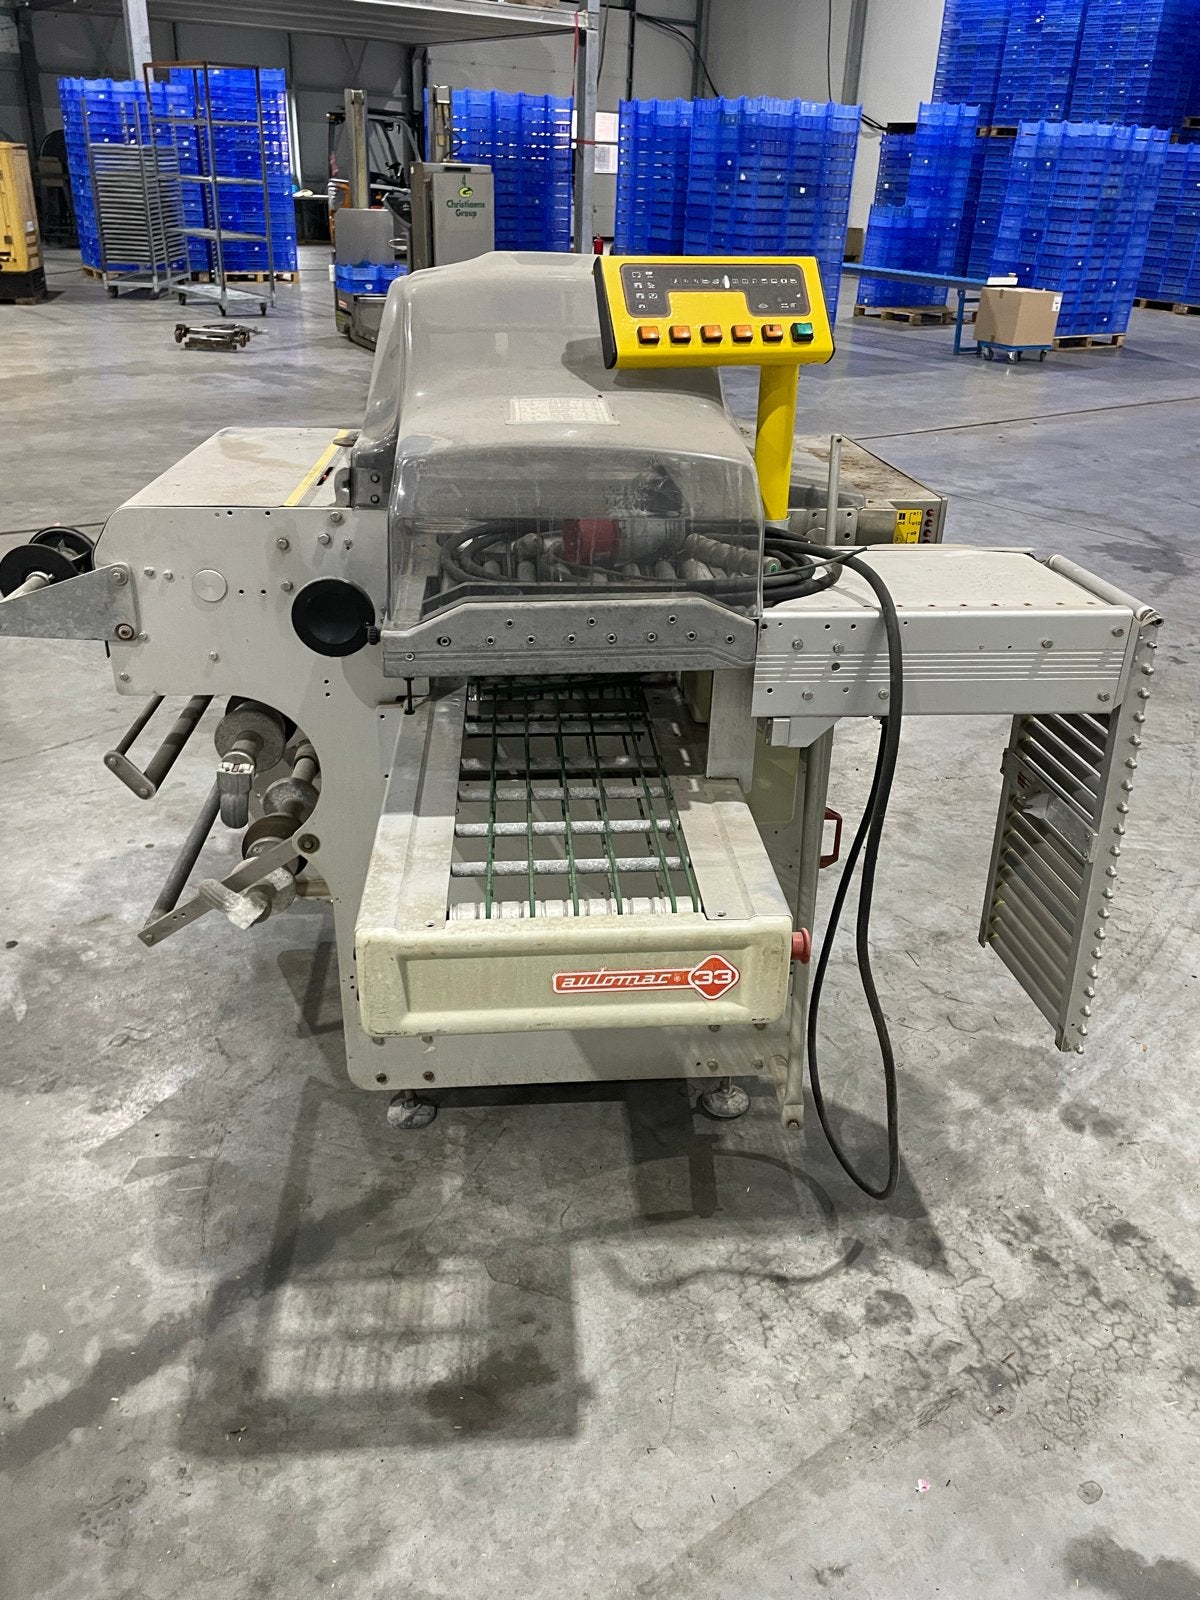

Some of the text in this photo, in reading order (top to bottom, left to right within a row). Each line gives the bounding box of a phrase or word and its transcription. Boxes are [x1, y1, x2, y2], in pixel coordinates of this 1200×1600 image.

[446, 199, 485, 208] Christiaens
[455, 208, 478, 219] Group
[561, 967, 733, 988] automac 33
